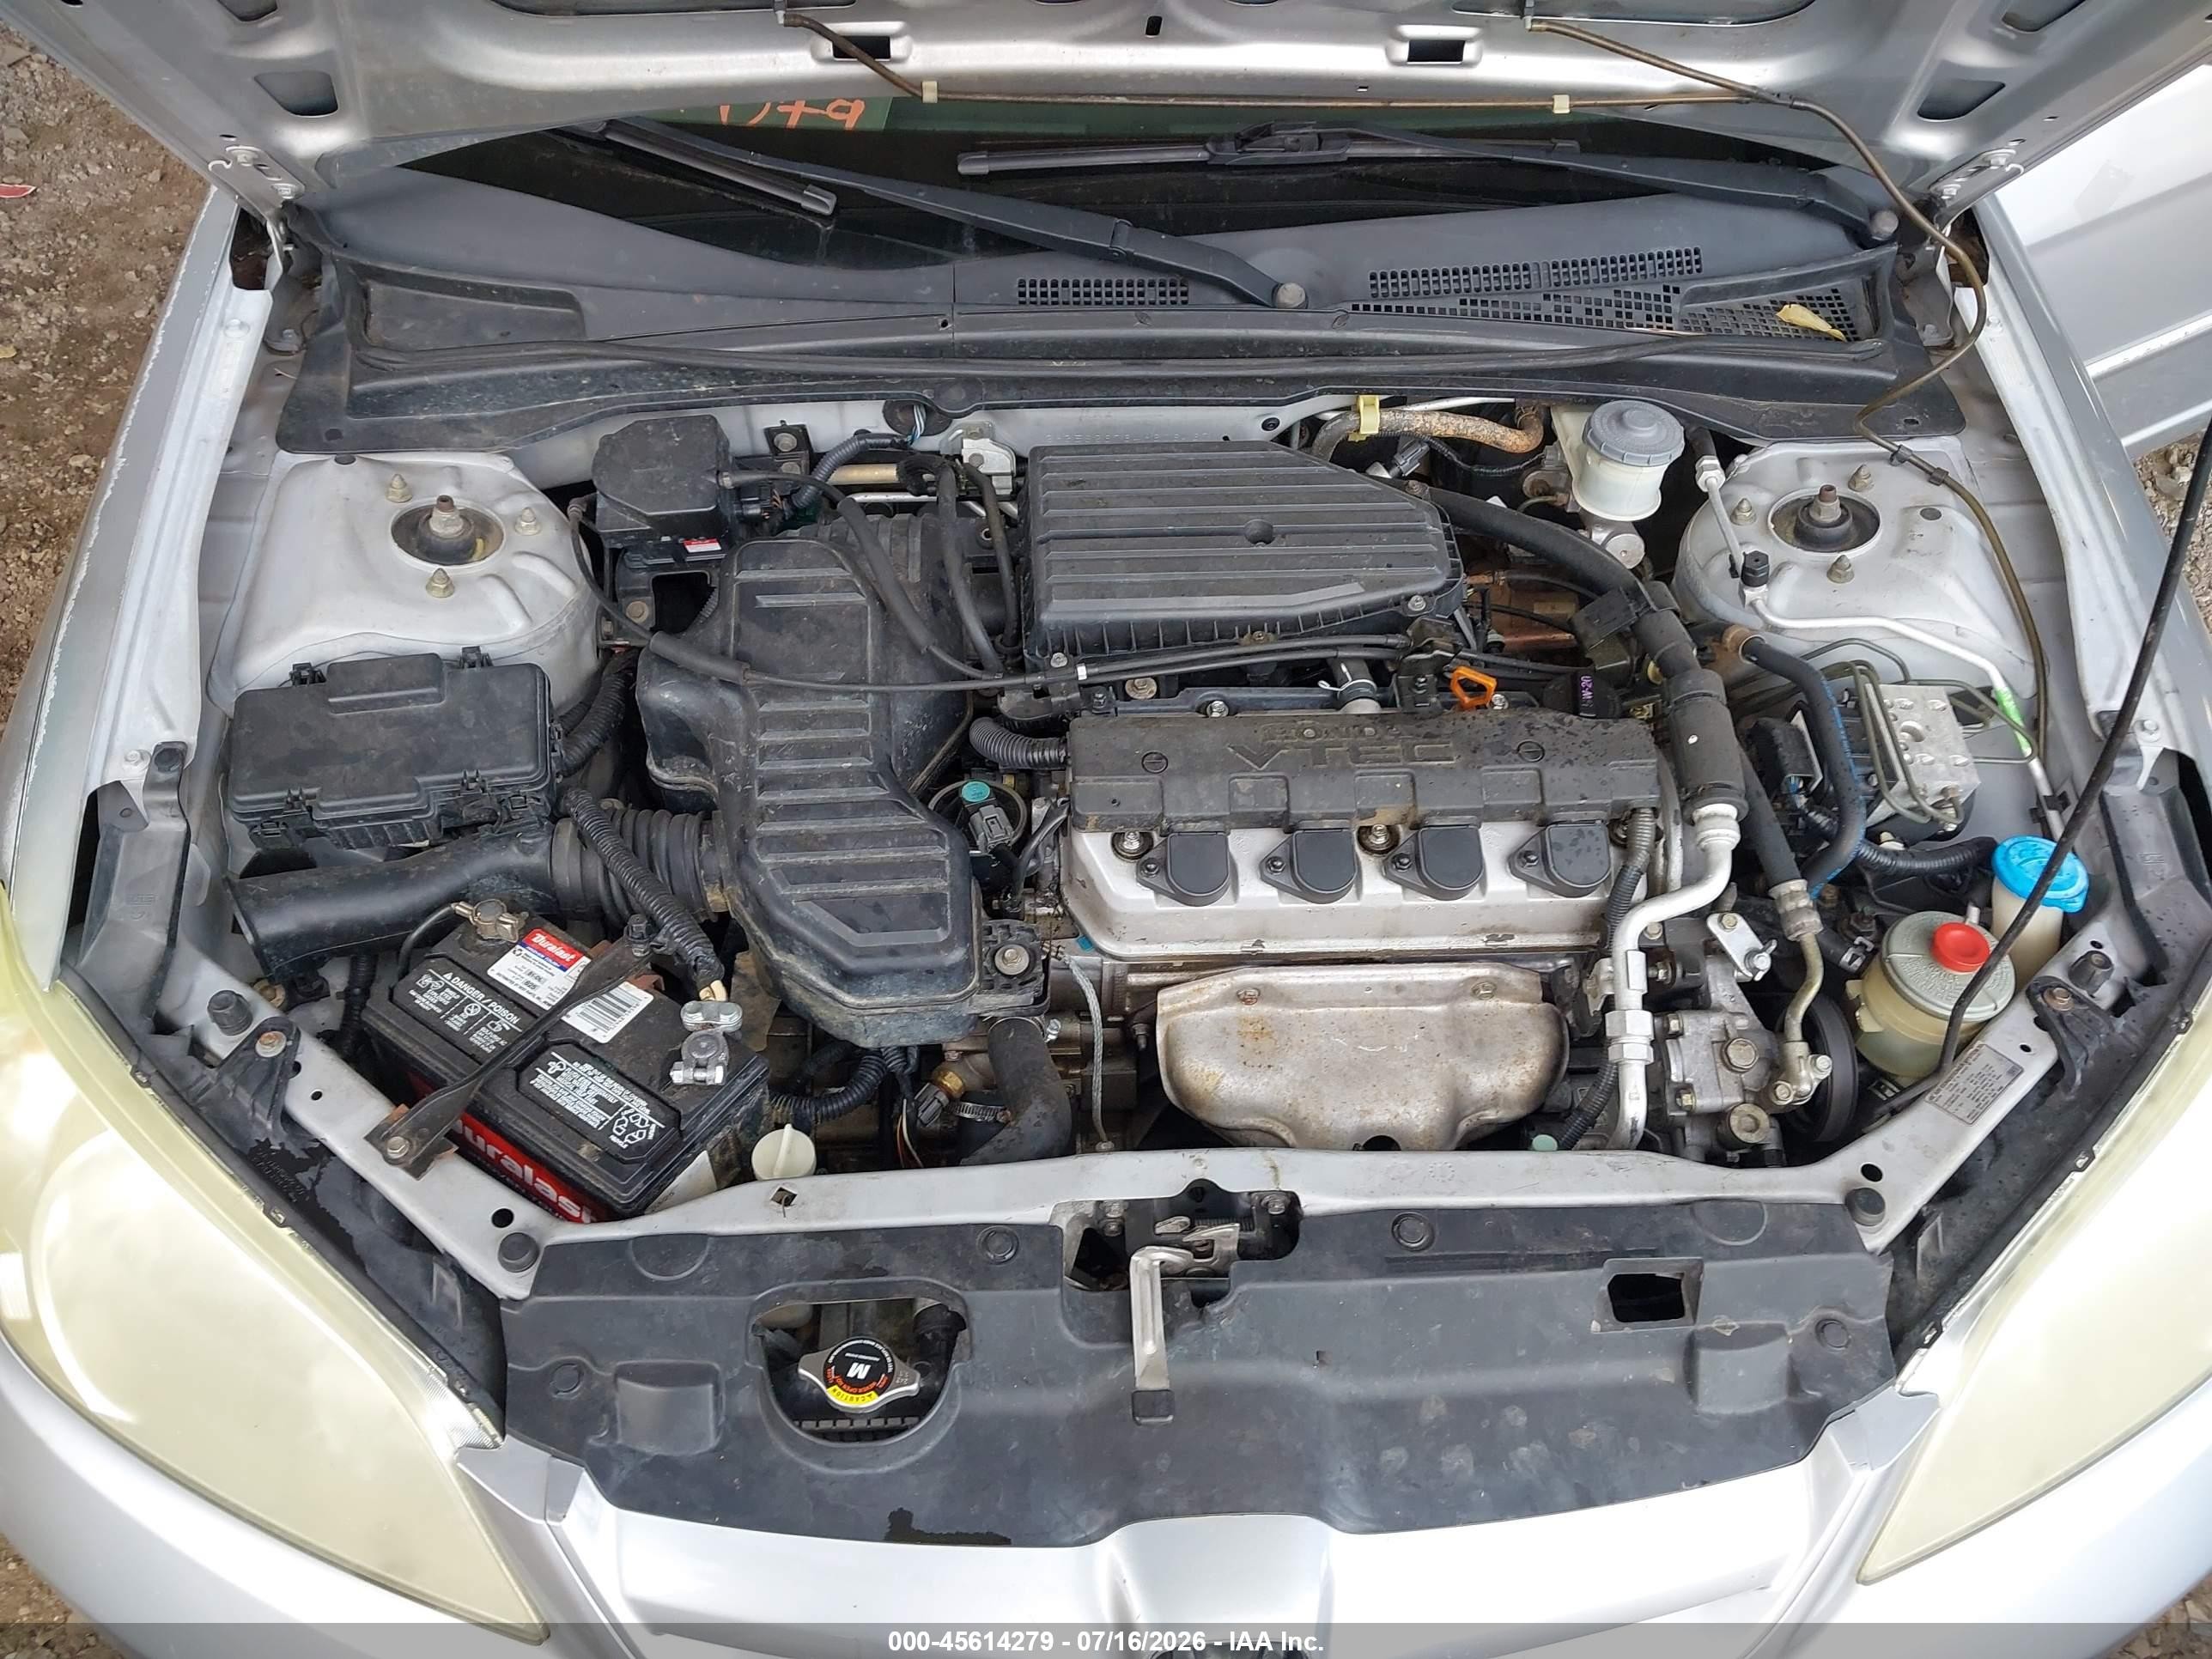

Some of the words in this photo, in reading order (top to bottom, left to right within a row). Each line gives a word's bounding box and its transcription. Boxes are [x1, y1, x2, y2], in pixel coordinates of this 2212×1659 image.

[1227, 742, 1458, 770] VTEC
[532, 933, 577, 962] Duralast
[451, 976, 485, 1001] DANGER
[488, 1001, 521, 1024] POISON
[846, 1362, 872, 1380] M
[831, 1387, 866, 1402] CAUTION
